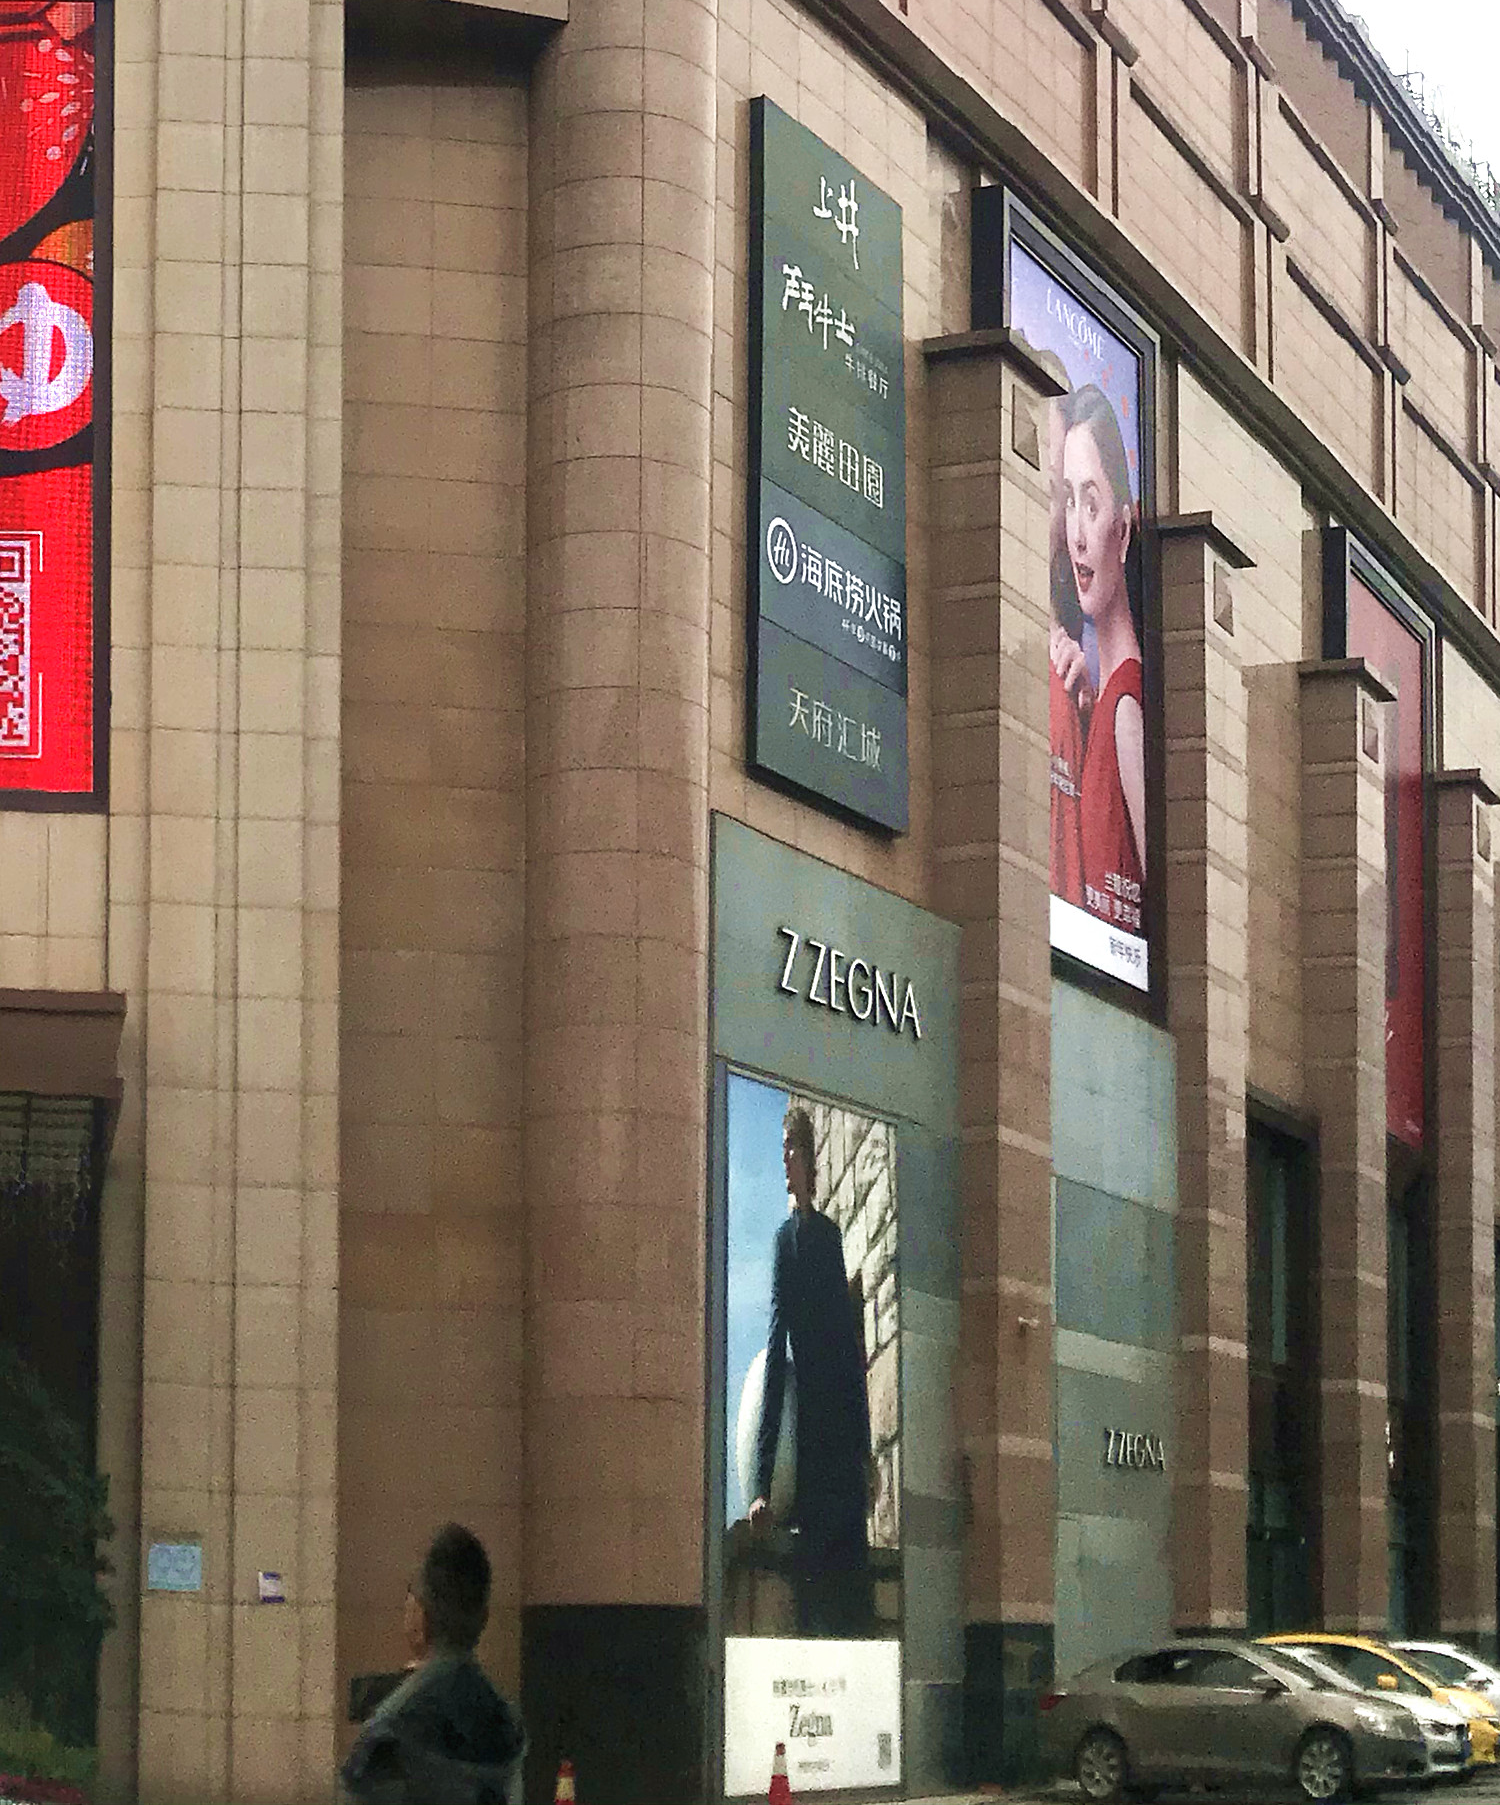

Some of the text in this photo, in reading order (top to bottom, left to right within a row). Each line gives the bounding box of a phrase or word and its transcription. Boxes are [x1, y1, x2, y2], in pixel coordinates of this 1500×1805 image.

[813, 176, 859, 270] 上井
[801, 542, 902, 641] 海底捞火锅
[789, 687, 882, 772] 天府汇城
[781, 927, 922, 1039] Z ZEGNA
